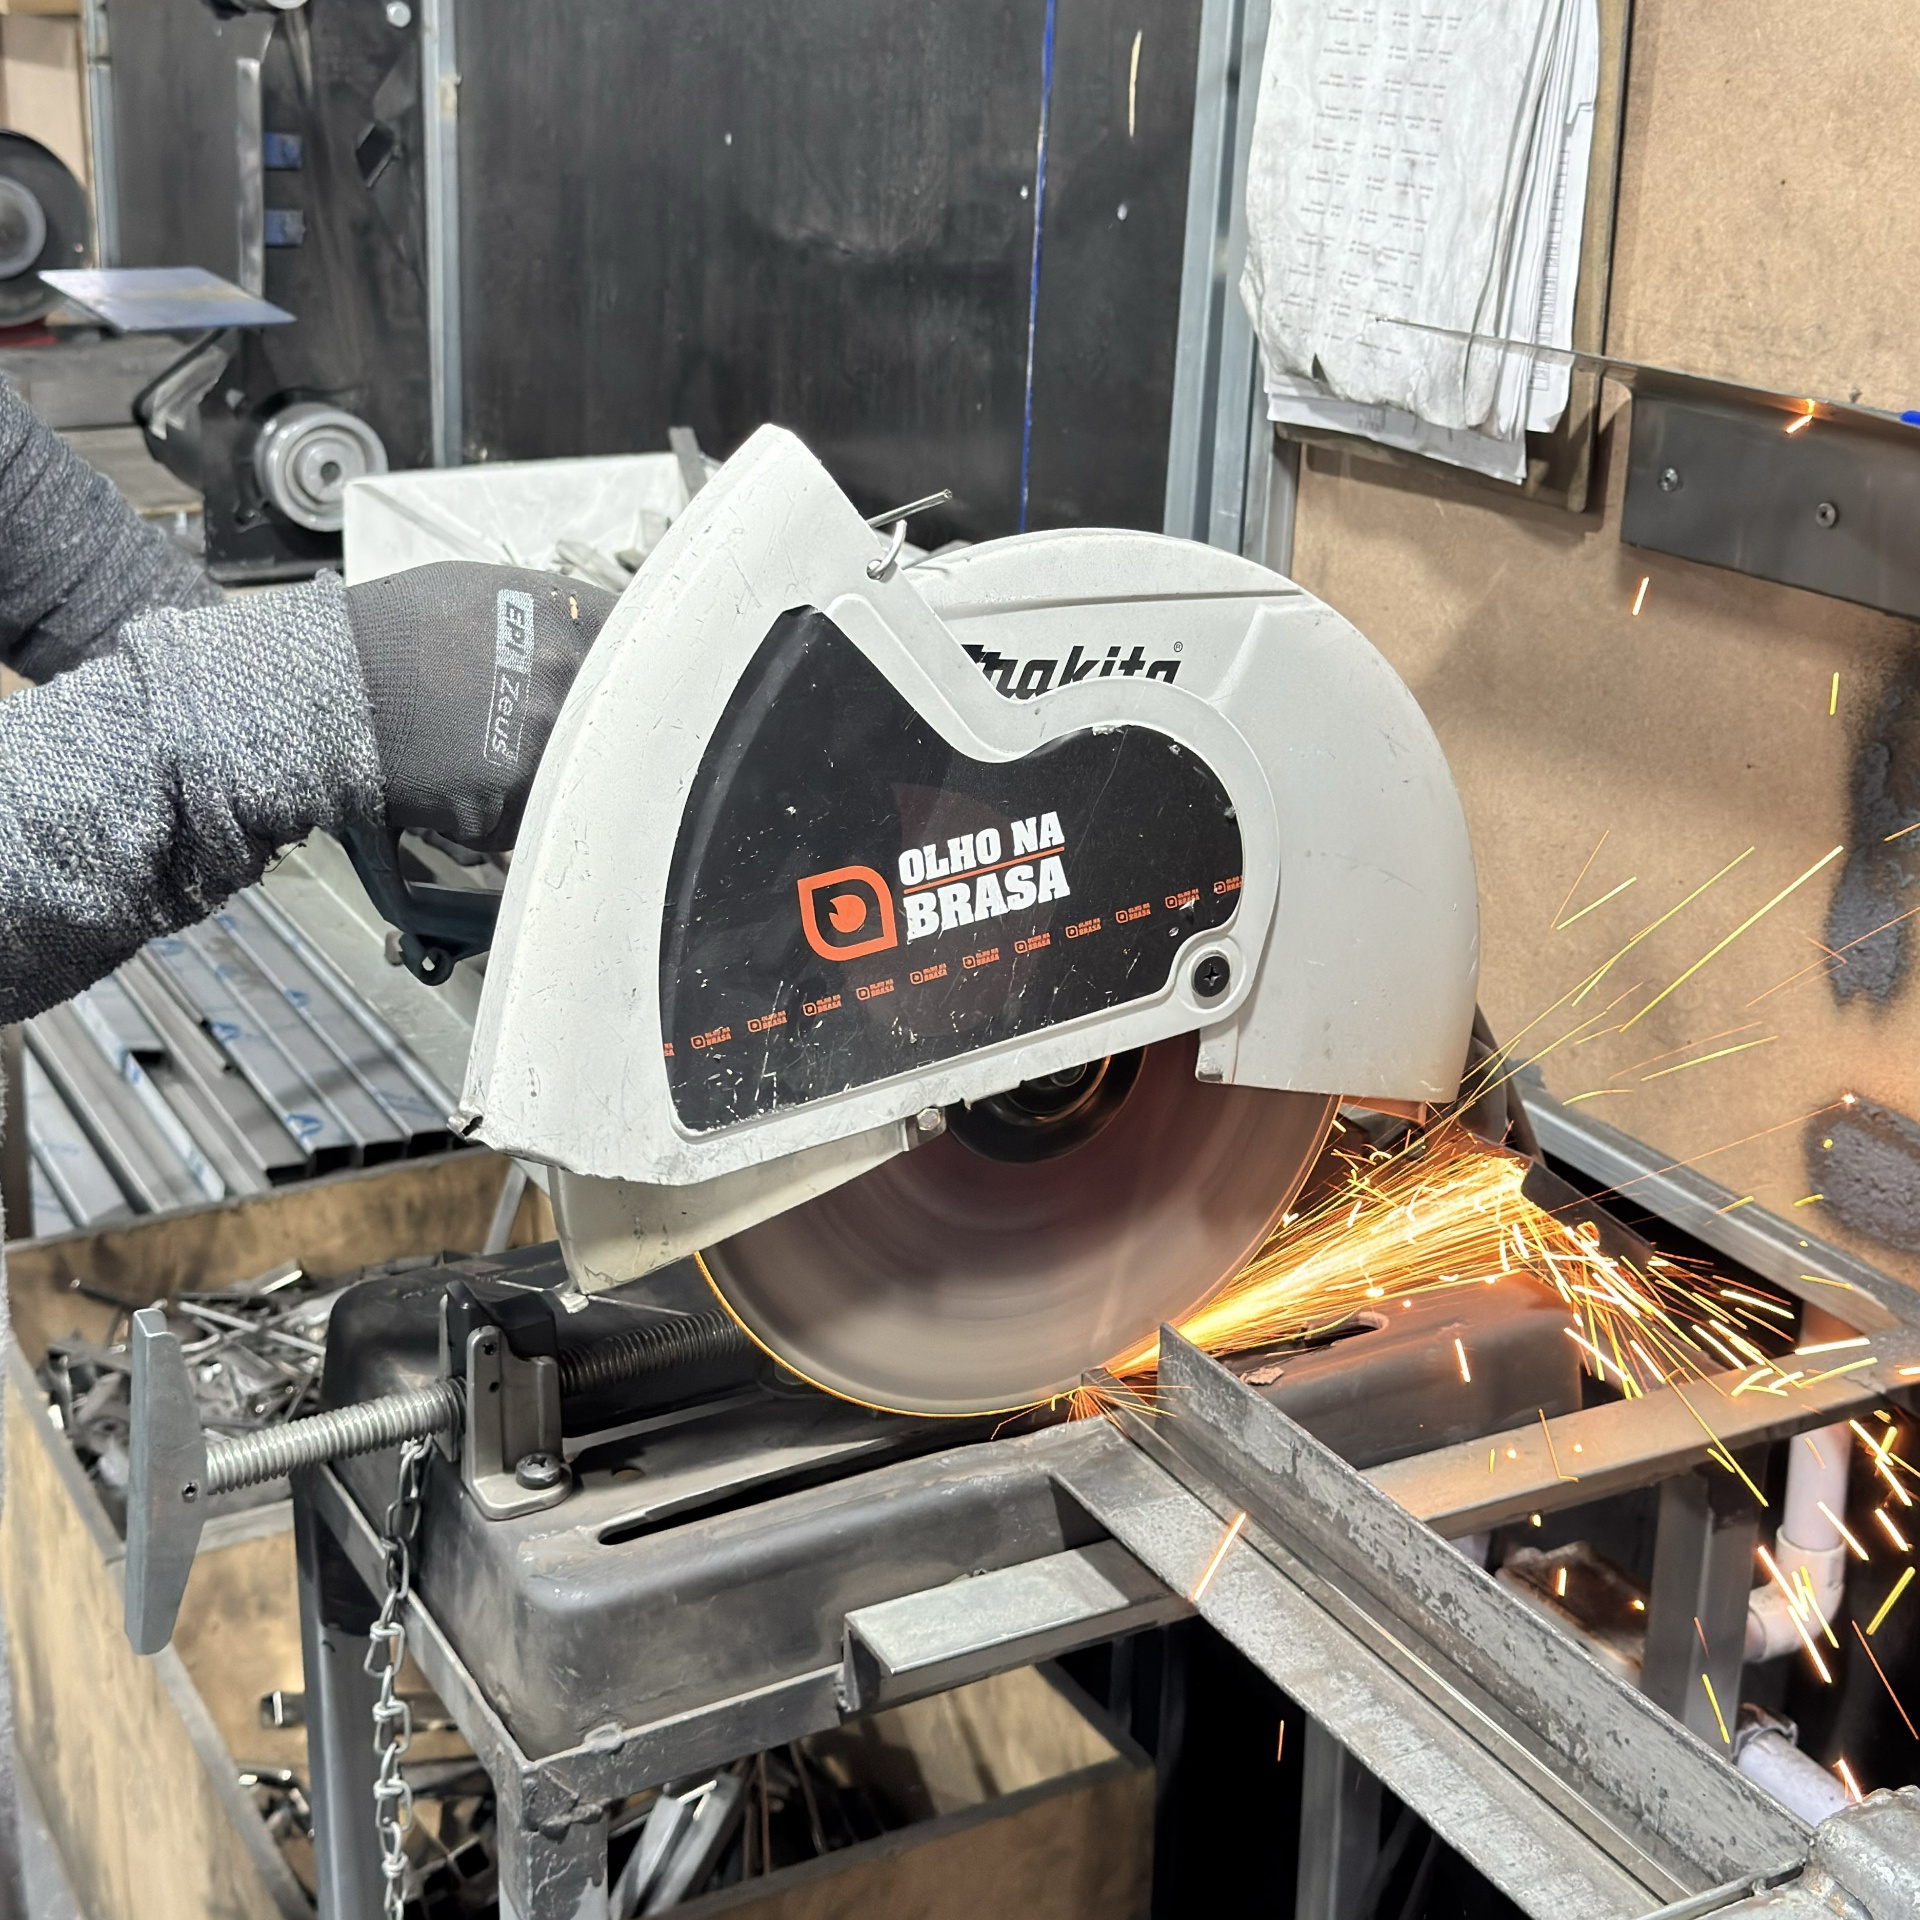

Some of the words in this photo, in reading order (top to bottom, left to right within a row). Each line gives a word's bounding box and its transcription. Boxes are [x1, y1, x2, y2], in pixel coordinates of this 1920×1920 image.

[898, 828, 1001, 886] OLHO
[1010, 811, 1065, 856] NA
[903, 855, 1070, 944] BRASA
